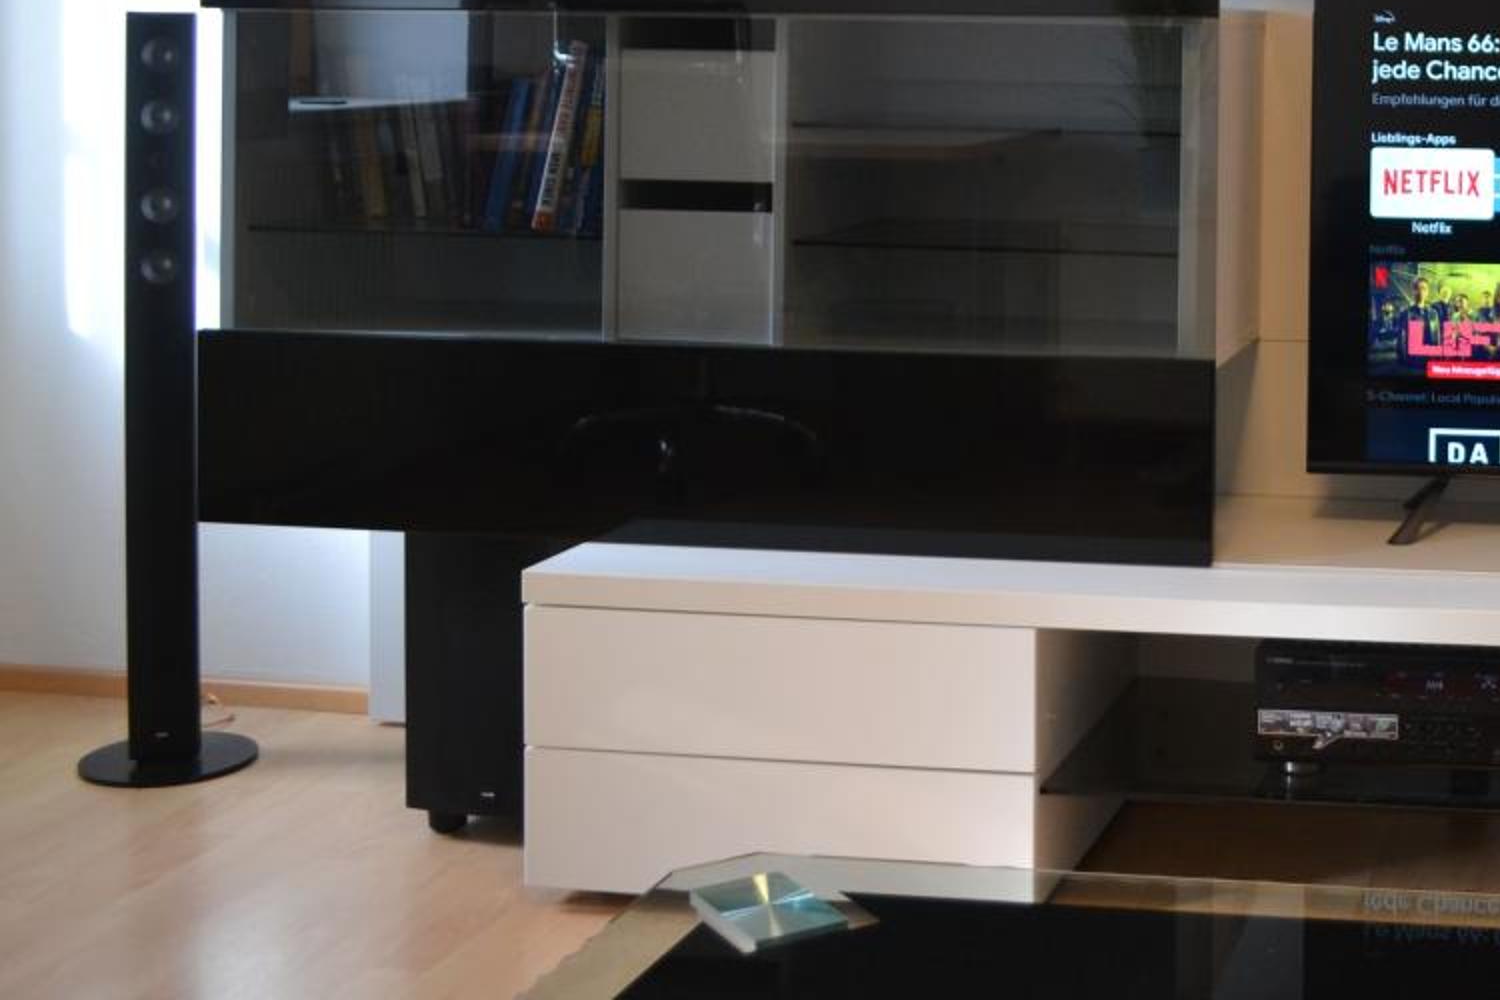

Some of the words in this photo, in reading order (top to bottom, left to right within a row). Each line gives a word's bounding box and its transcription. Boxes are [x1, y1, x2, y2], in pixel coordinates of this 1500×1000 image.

[1372, 31, 1399, 52] Le
[1404, 31, 1463, 53] Mans
[1467, 33, 1500, 54] 66:
[1371, 59, 1421, 84] jede
[1371, 92, 1465, 108] Empfehlungen
[1468, 92, 1487, 106] für
[1371, 132, 1457, 145] Lieblings-Apps
[1382, 168, 1480, 198] NETFLIX
[1411, 221, 1452, 235] Netflix
